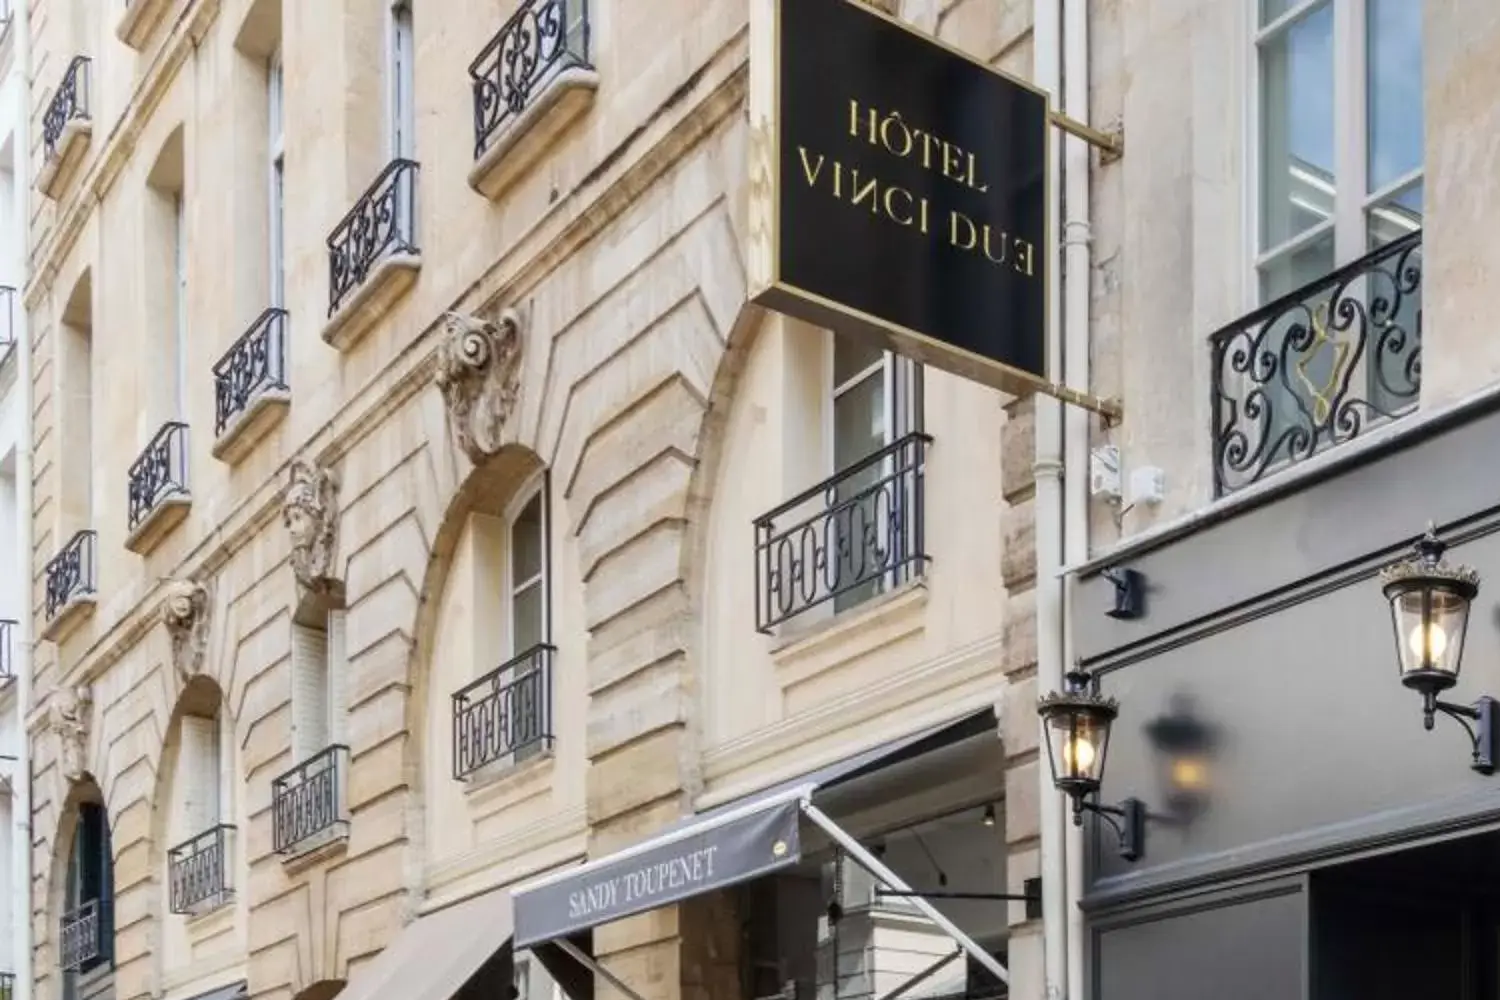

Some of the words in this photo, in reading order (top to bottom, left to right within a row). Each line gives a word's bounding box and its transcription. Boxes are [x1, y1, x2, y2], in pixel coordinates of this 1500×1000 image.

[849, 99, 989, 193] HÔTEL
[798, 146, 928, 233] VINCI
[947, 210, 1034, 276] DUE
[569, 878, 619, 918] SANDY
[624, 845, 717, 901] TOUPENET
